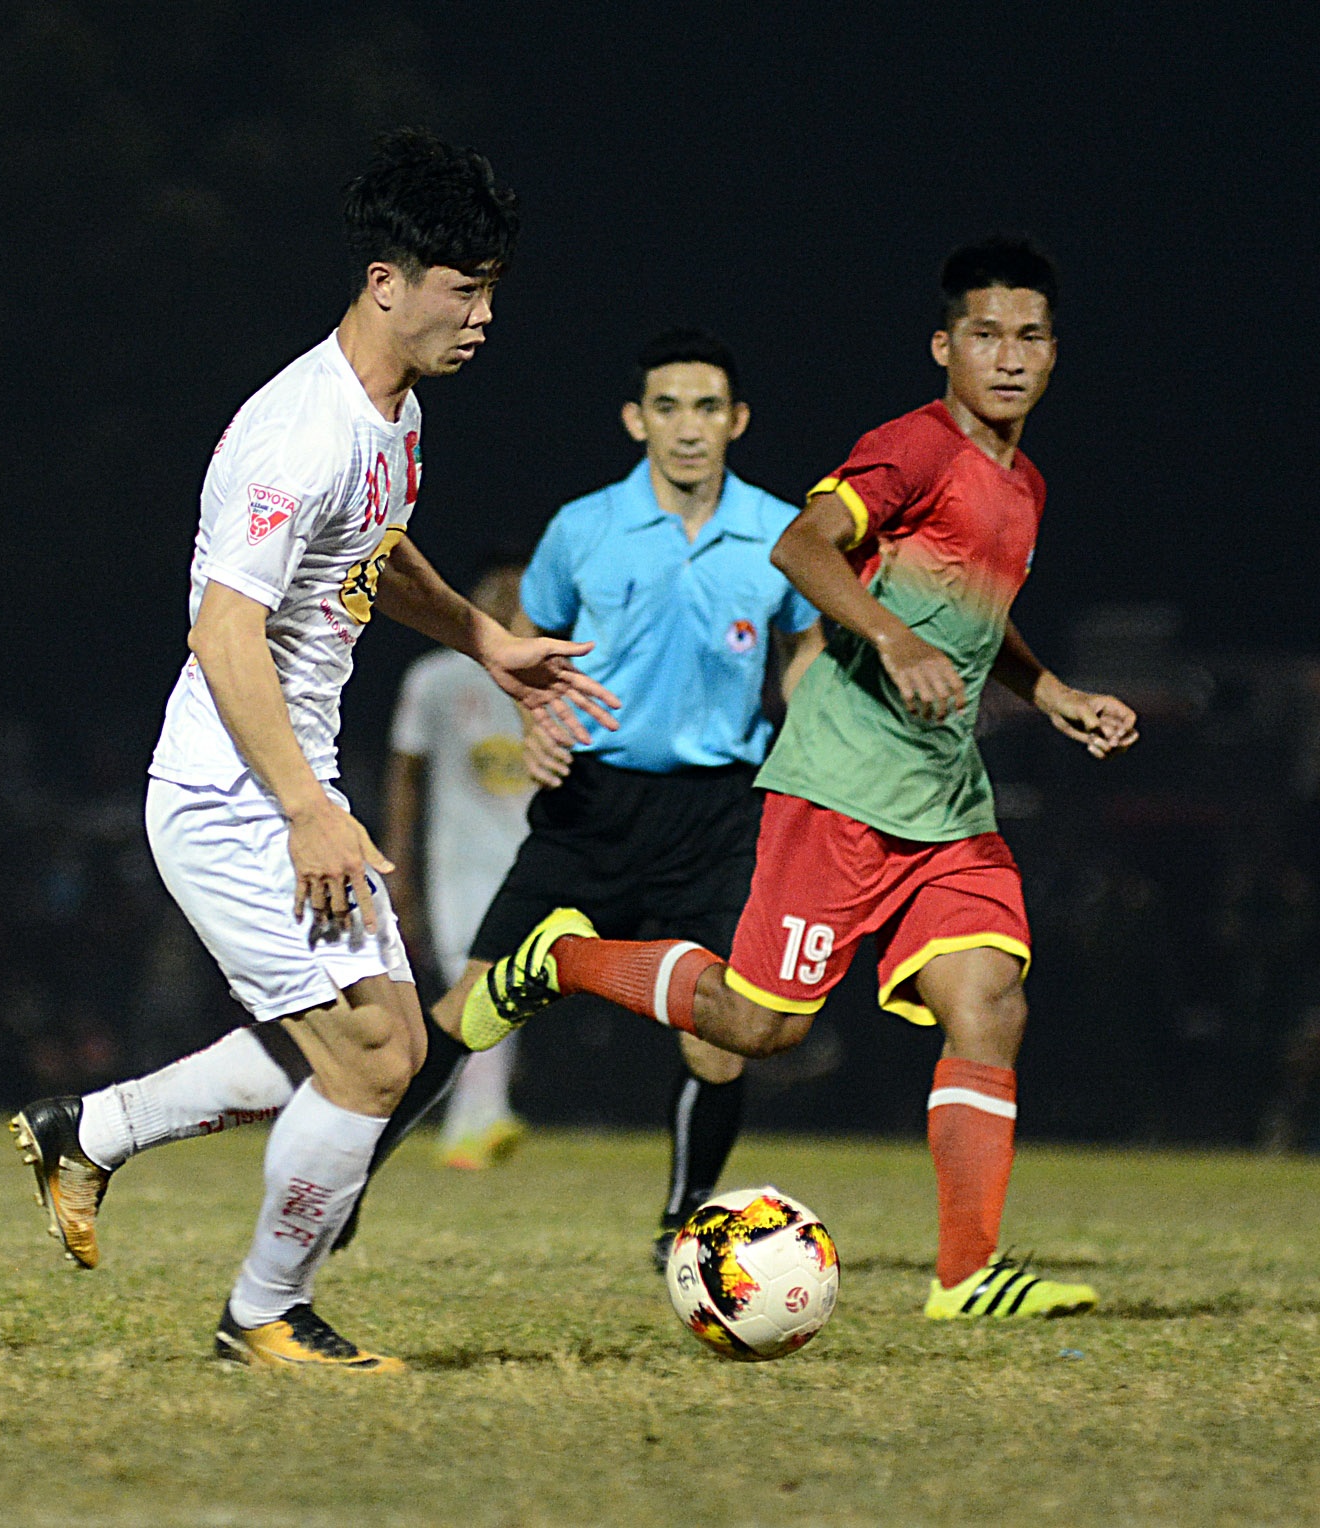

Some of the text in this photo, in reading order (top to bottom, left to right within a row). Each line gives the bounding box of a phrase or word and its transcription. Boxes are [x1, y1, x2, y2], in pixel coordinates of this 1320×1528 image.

[253, 488, 295, 513] TOYOTA
[780, 914, 835, 985] 19
[282, 1177, 336, 1224] HAGL
